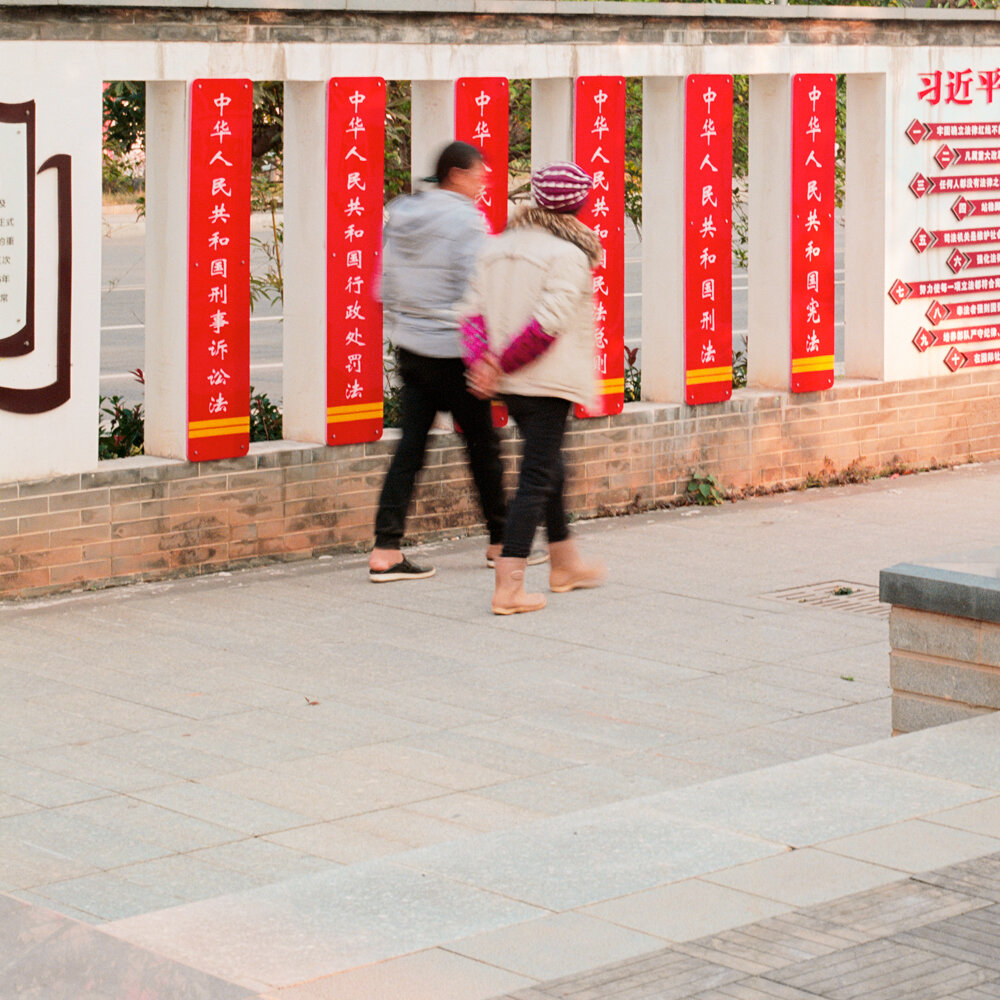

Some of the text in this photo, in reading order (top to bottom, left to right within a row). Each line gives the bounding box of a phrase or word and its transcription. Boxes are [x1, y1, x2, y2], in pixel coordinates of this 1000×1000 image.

[941, 150, 950, 162] 二
[916, 180, 925, 191] 三
[958, 203, 967, 214] 四
[700, 86, 719, 364] 中华人民共和国刑法
[804, 85, 823, 354] 中华人民共和国宪法
[343, 89, 367, 400] 中华人民共和国行政处罚法
[918, 234, 927, 246] 五
[208, 91, 233, 414] 中华人民共和国刑事诉讼法
[953, 255, 962, 267] 六
[895, 285, 905, 298] 七
[933, 307, 942, 319] 八
[920, 334, 929, 346] 九
[951, 353, 960, 366] 十
